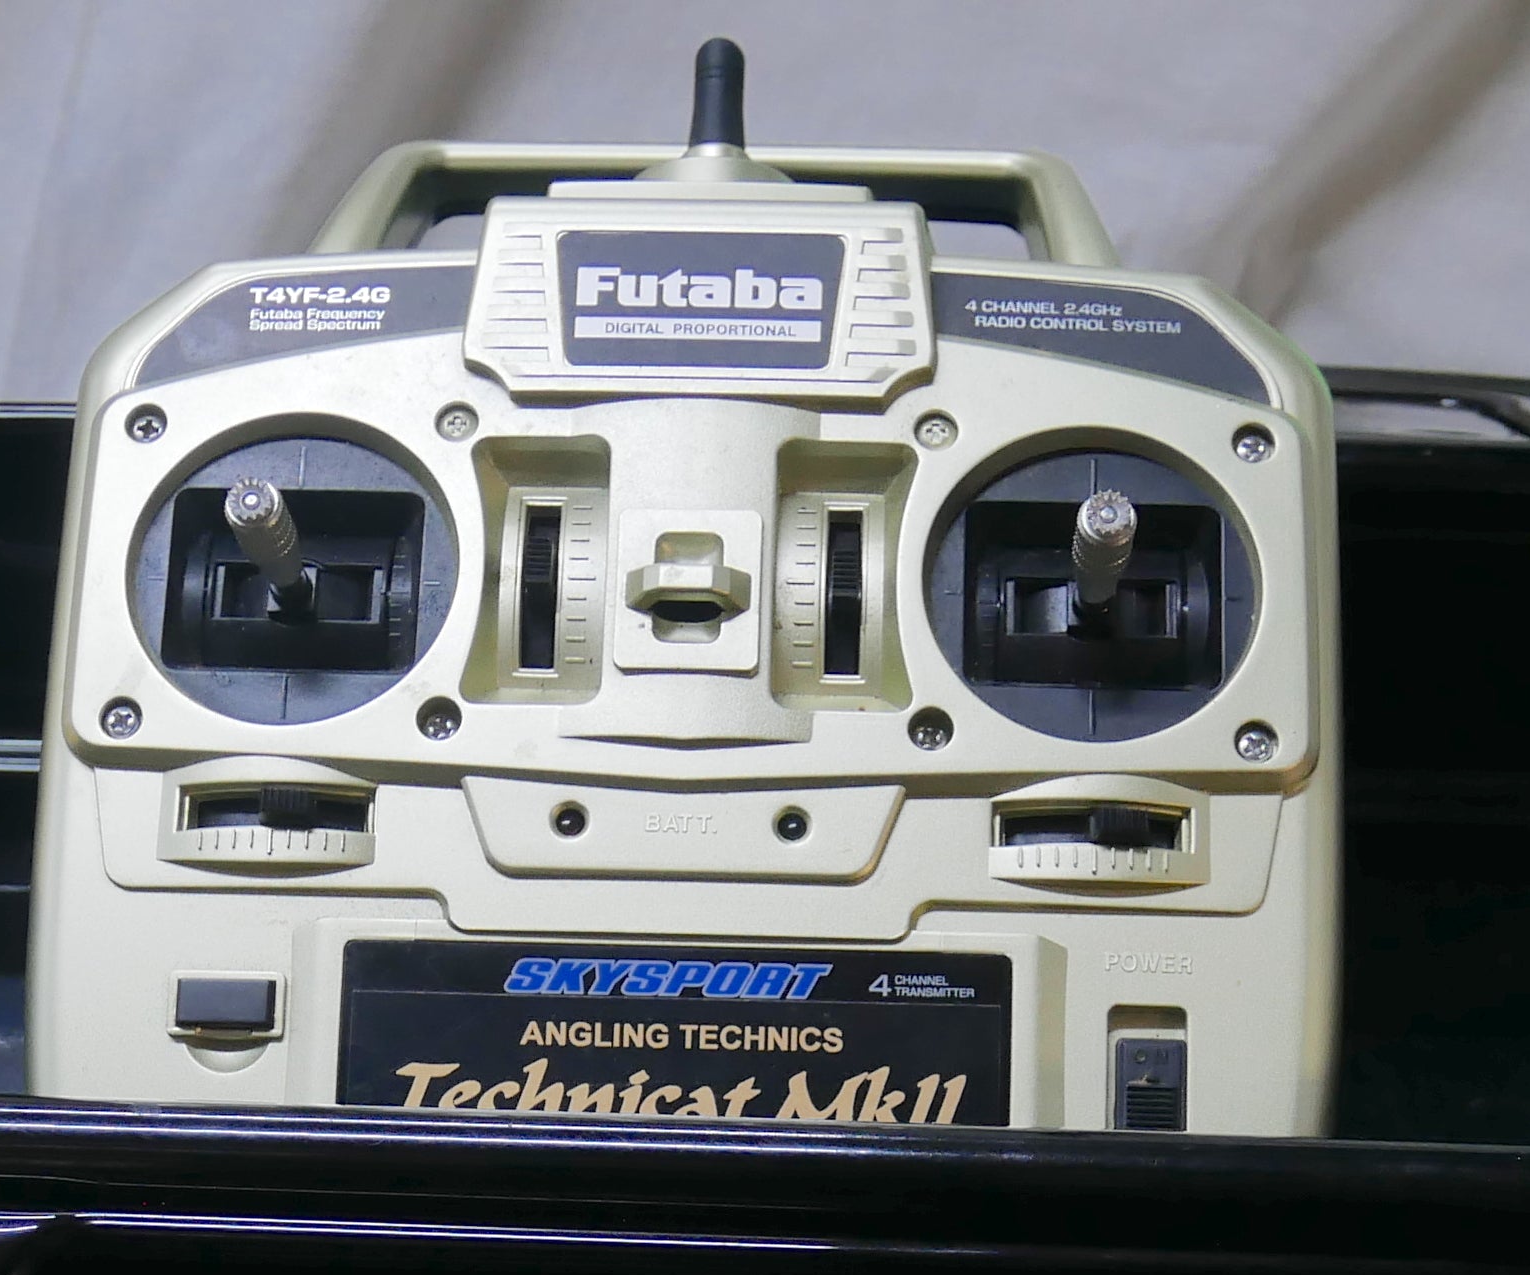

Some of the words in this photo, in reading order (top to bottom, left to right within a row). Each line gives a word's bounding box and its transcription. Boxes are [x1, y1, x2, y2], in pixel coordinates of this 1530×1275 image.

[249, 286, 391, 304] T4YF-2.4G
[575, 265, 823, 311] Futaba
[250, 308, 303, 320] Futaba
[306, 308, 385, 321] Frequency
[965, 300, 977, 312] 4
[981, 301, 1059, 315] CHANNEL
[1063, 303, 1123, 317] 2.4GHz
[249, 319, 303, 332] Spread
[306, 320, 381, 332] Spectrum
[605, 322, 664, 334] DIGITAL
[673, 323, 796, 337] PROPORTIONAL
[974, 315, 1026, 329] RADIO
[1030, 316, 1108, 332] CONTROL
[1112, 319, 1182, 334] SYSTEM
[1104, 952, 1194, 974] POWER
[504, 957, 833, 1000] SKYSPORT
[869, 974, 892, 997] 4
[894, 975, 949, 986] CHANNEL
[894, 987, 975, 998] TRANSMITTER
[519, 1021, 669, 1049] ANGLING
[679, 1024, 844, 1053] TECHNICS
[395, 1057, 761, 1117] Technicat
